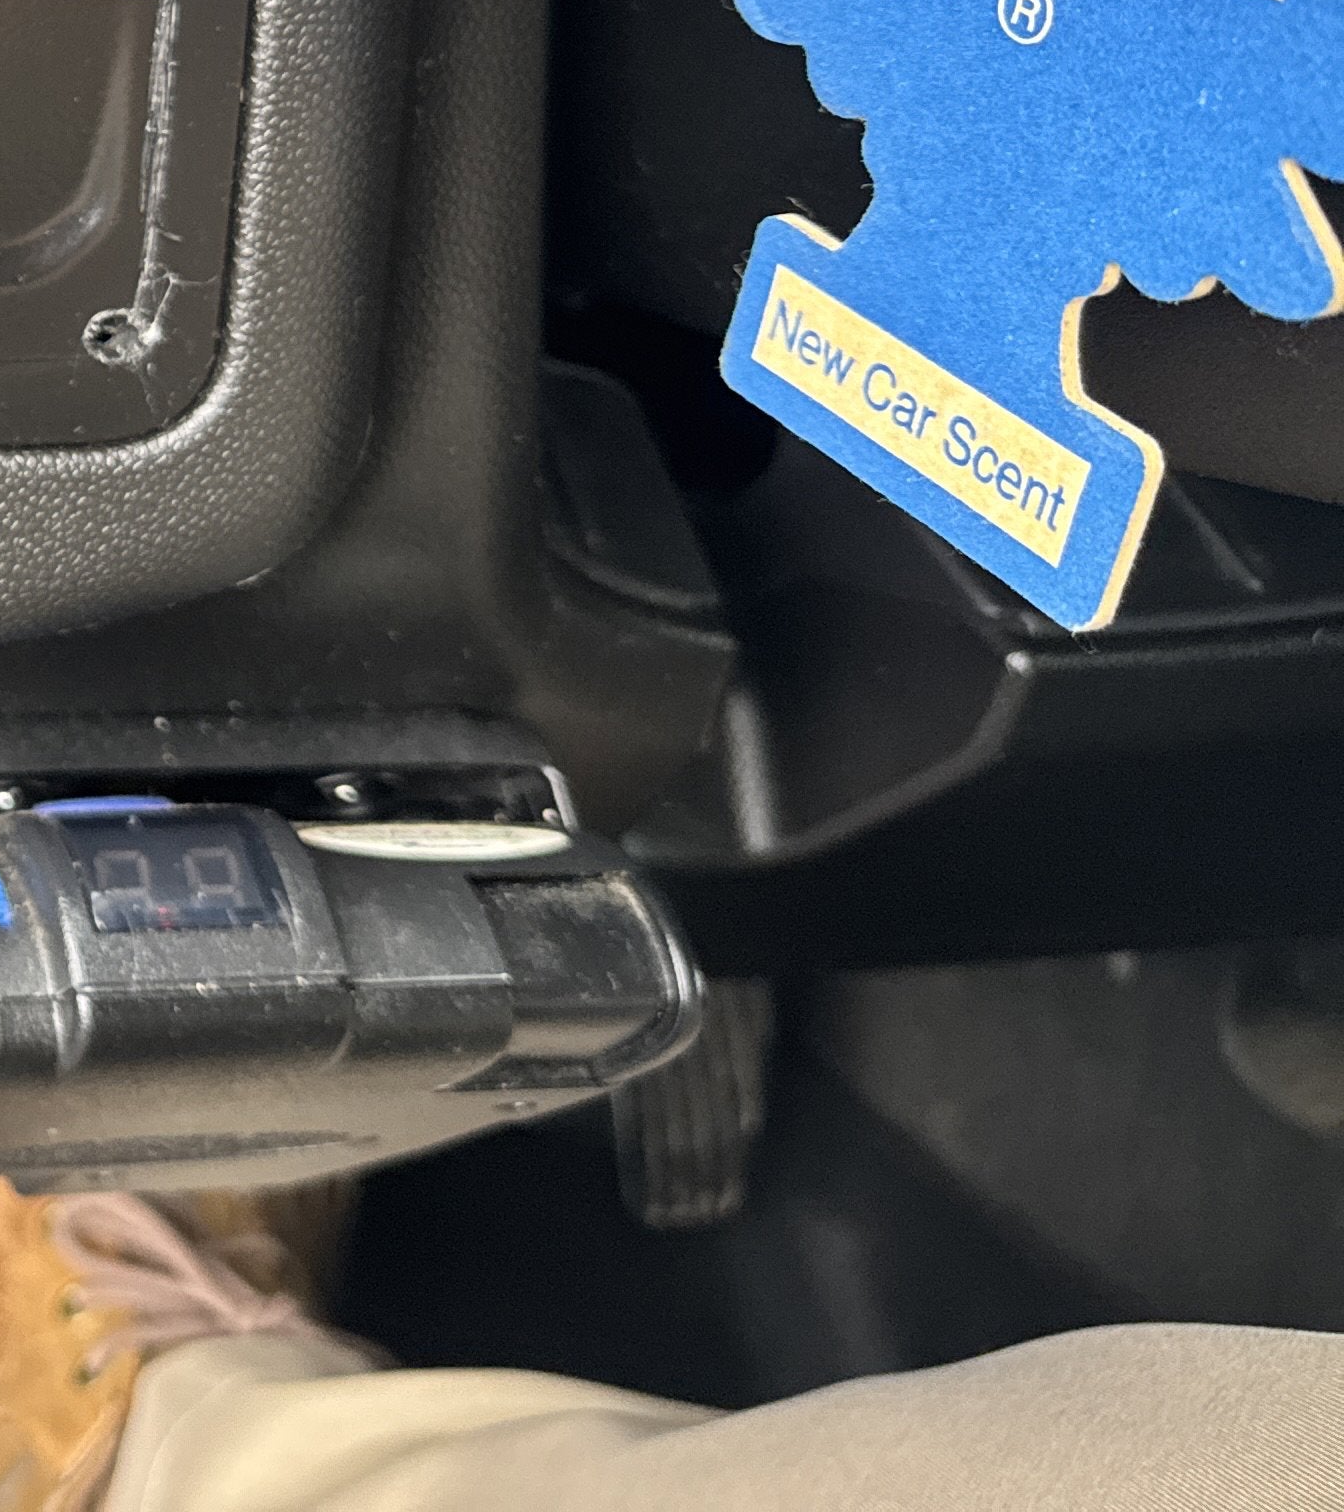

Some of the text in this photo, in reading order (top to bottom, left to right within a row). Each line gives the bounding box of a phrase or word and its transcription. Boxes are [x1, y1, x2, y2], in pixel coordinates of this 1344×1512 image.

[767, 296, 1067, 533] New Car Scent
